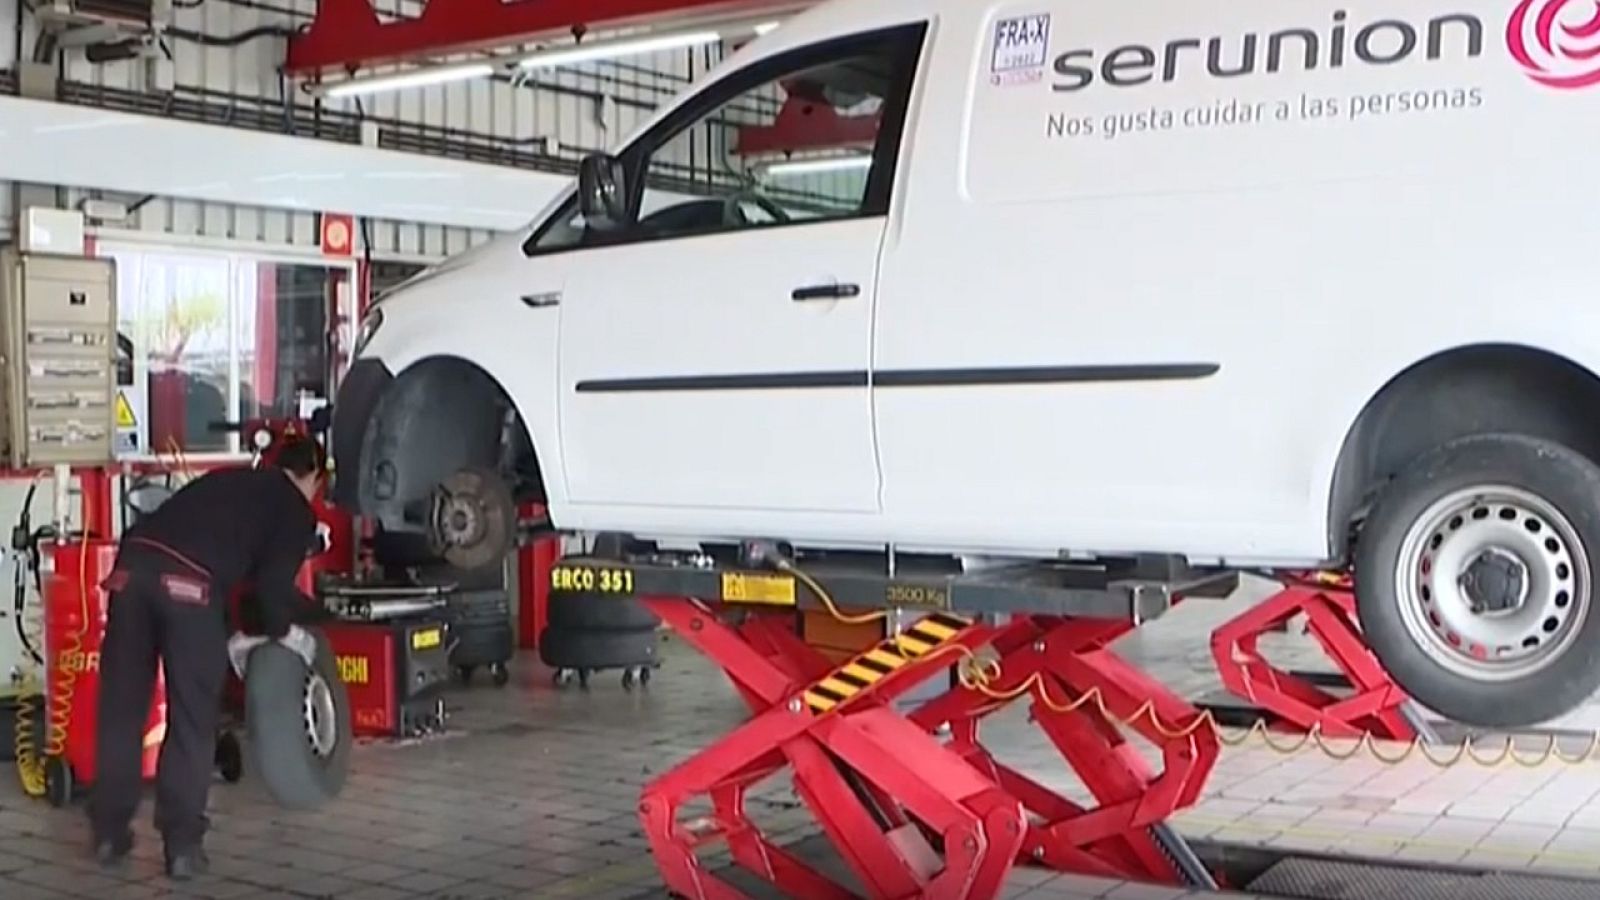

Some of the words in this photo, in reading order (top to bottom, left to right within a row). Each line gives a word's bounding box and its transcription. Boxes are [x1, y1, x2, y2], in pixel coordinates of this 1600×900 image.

[1052, 10, 1483, 91] serunion
[1046, 112, 1094, 137] Nos
[1103, 107, 1173, 139] gusta
[1183, 98, 1264, 128] cuidar
[1275, 101, 1289, 121] a
[1300, 93, 1339, 119] las
[1349, 87, 1482, 121] personas
[600, 570, 633, 593] 351
